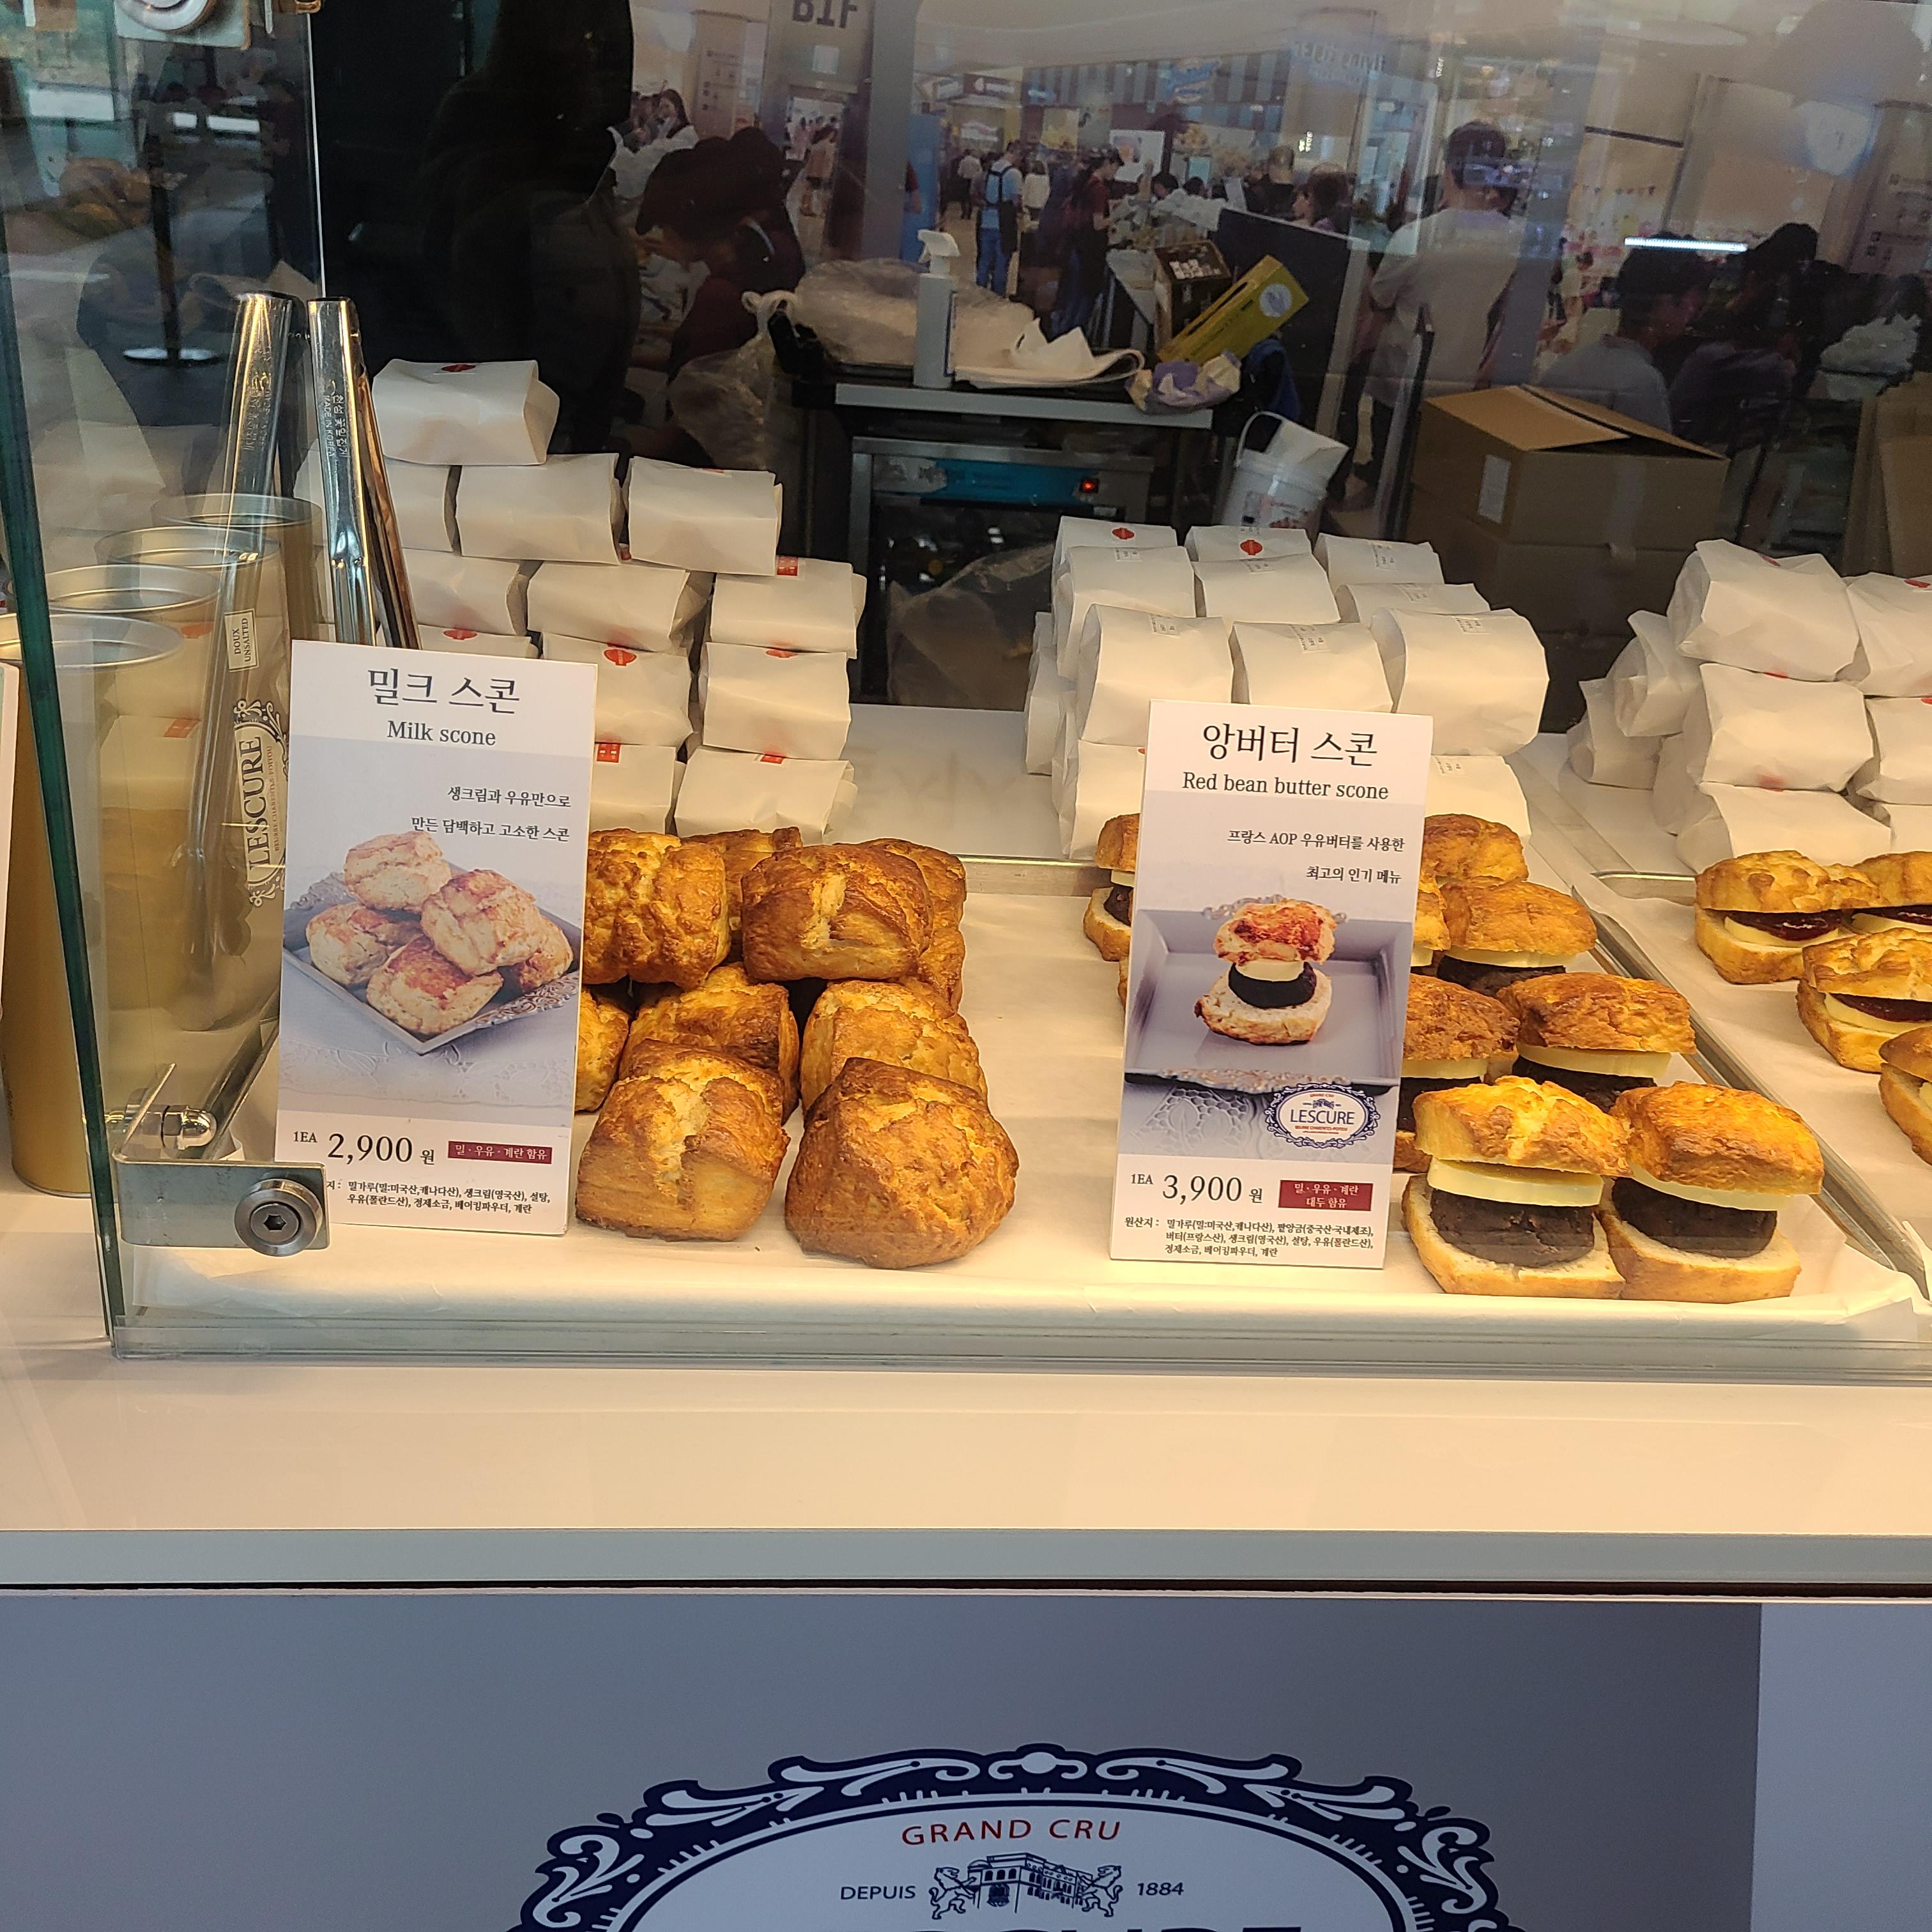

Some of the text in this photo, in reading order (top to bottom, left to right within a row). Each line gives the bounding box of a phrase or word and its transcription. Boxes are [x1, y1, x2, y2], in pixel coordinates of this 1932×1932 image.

[241, 618, 252, 663] UNSALTED
[368, 668, 520, 714] 밀크 스콘
[387, 720, 496, 746] Milk scone
[1203, 723, 1377, 767] 앙버터 스콘
[447, 786, 572, 808] 생크림과 우유만으로
[1182, 771, 1389, 800] Red bean butter scone
[238, 736, 272, 871] LESCURE
[411, 816, 571, 842] 만든 담백하고 고소한 스콘
[1227, 830, 1406, 852] 프랑스 AOP 우유버터를 사용한
[1306, 865, 1402, 885] 최고의 인기 메뉴
[1290, 1109, 1355, 1124] LESCURE
[293, 1131, 435, 1165] 1EA 2,900 원
[526, 1149, 548, 1160] 함유
[1131, 1174, 1263, 1205] 1EA 3,900 원
[1306, 1197, 1347, 1208] 대두 함유
[514, 1204, 532, 1214] 계란
[1261, 1247, 1278, 1257] 계란
[901, 1820, 1121, 1846] GRAND CRU
[840, 1883, 1184, 1900] DEPUIS 1884
